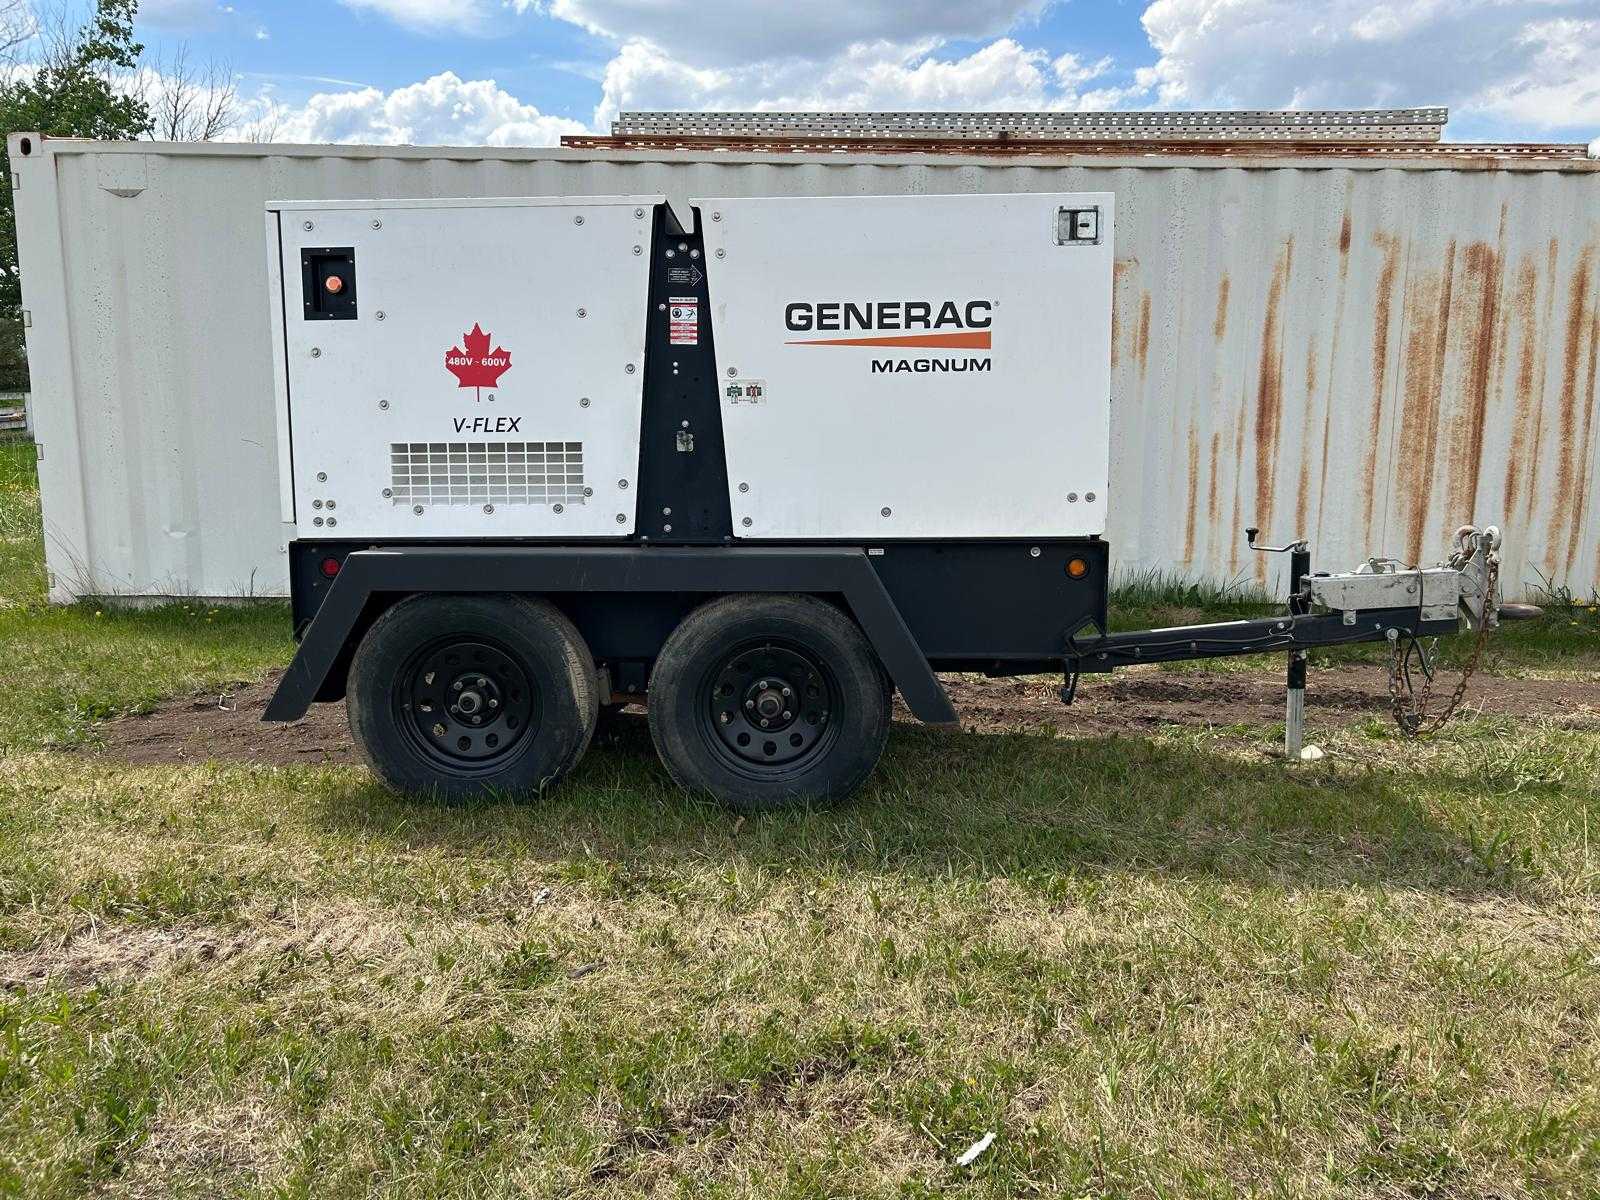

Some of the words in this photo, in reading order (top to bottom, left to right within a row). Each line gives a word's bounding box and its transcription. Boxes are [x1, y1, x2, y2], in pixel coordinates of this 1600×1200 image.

[785, 301, 992, 330] GENERAC
[448, 357, 473, 366] 480V
[481, 358, 507, 367] 600V
[871, 358, 992, 373] MAGNUM
[453, 416, 522, 433] V-FLEX
